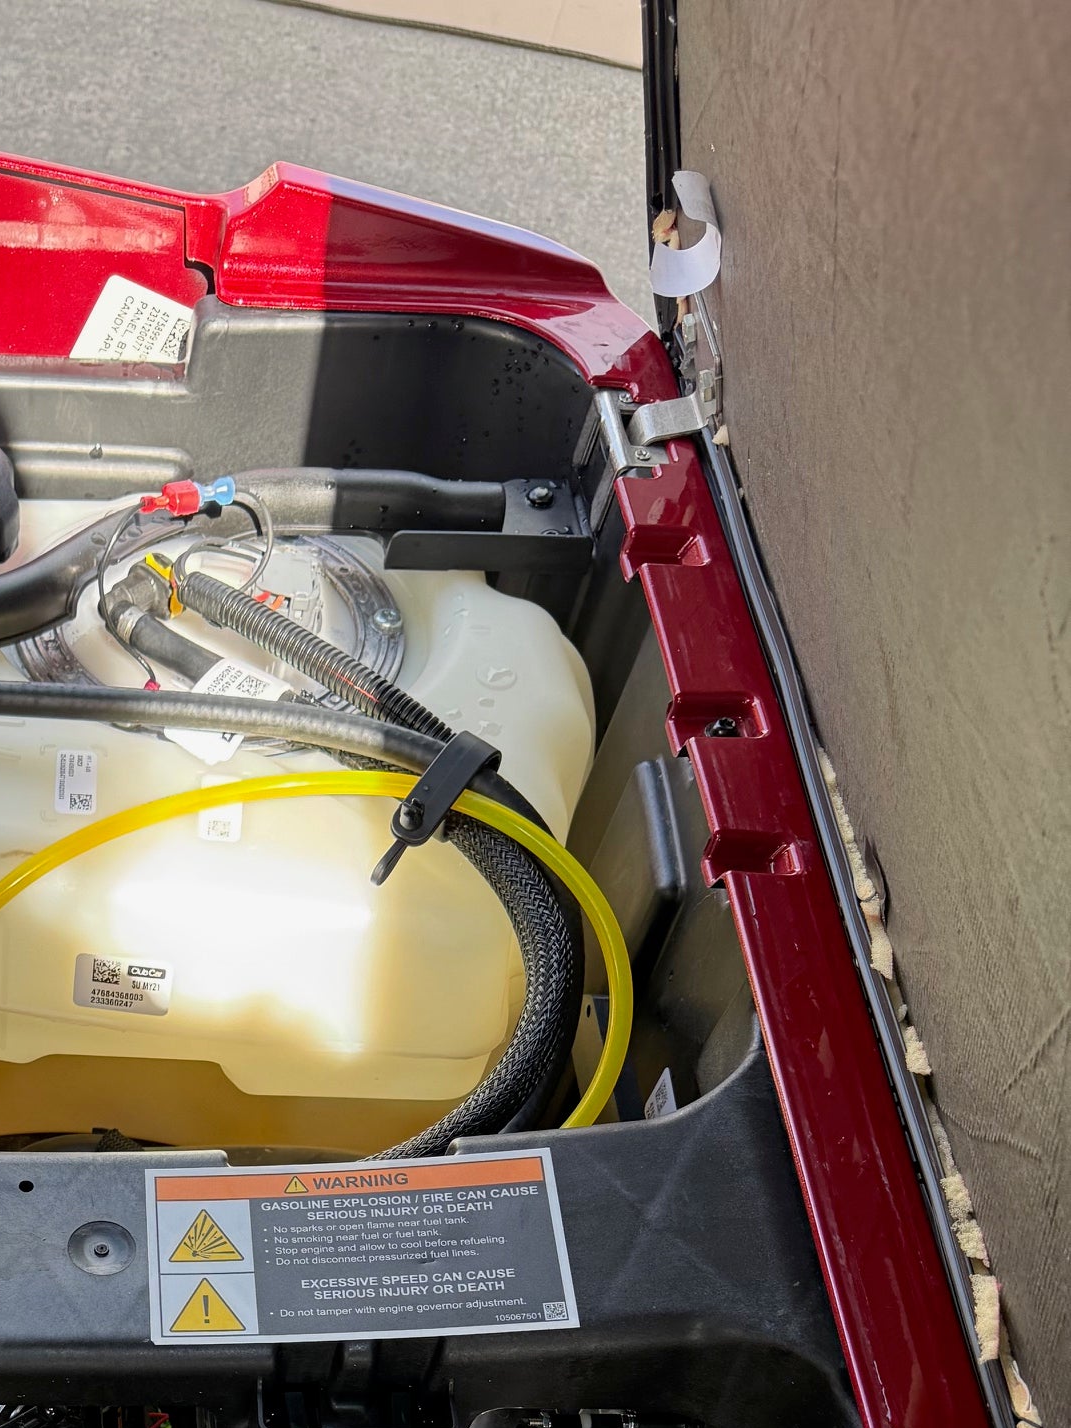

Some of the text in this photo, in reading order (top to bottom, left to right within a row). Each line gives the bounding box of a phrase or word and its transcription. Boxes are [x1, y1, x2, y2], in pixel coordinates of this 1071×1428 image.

[110, 295, 135, 333] CANDY
[312, 1172, 409, 1190] WARNING
[260, 1185, 539, 1211] GASOLINE EXPLOSION / FIRE CAN CAUSE
[307, 1201, 493, 1220] SERIOUS INJURY OR DEATH
[273, 1225, 288, 1233] No
[289, 1224, 324, 1234] sparks
[338, 1223, 364, 1232] open
[366, 1221, 395, 1229] flame
[422, 1217, 442, 1226] fuel
[444, 1216, 469, 1224] tank.
[273, 1236, 289, 1244] No
[291, 1234, 333, 1244] smoking
[360, 1231, 380, 1240] fuel
[395, 1229, 414, 1238] fuel
[416, 1228, 442, 1237] tank.
[274, 1235, 508, 1256] Stop engine and allow to cool before refueling.
[275, 1249, 479, 1266] Do not disconnect pressurized fuel lines.
[301, 1267, 516, 1289] EXCESSIVE SPEED CAN CAUSE
[313, 1280, 505, 1300] SERIOUS INJURY OR DEATH
[279, 1297, 527, 1317] Do not tamper with engine governor adjustment.
